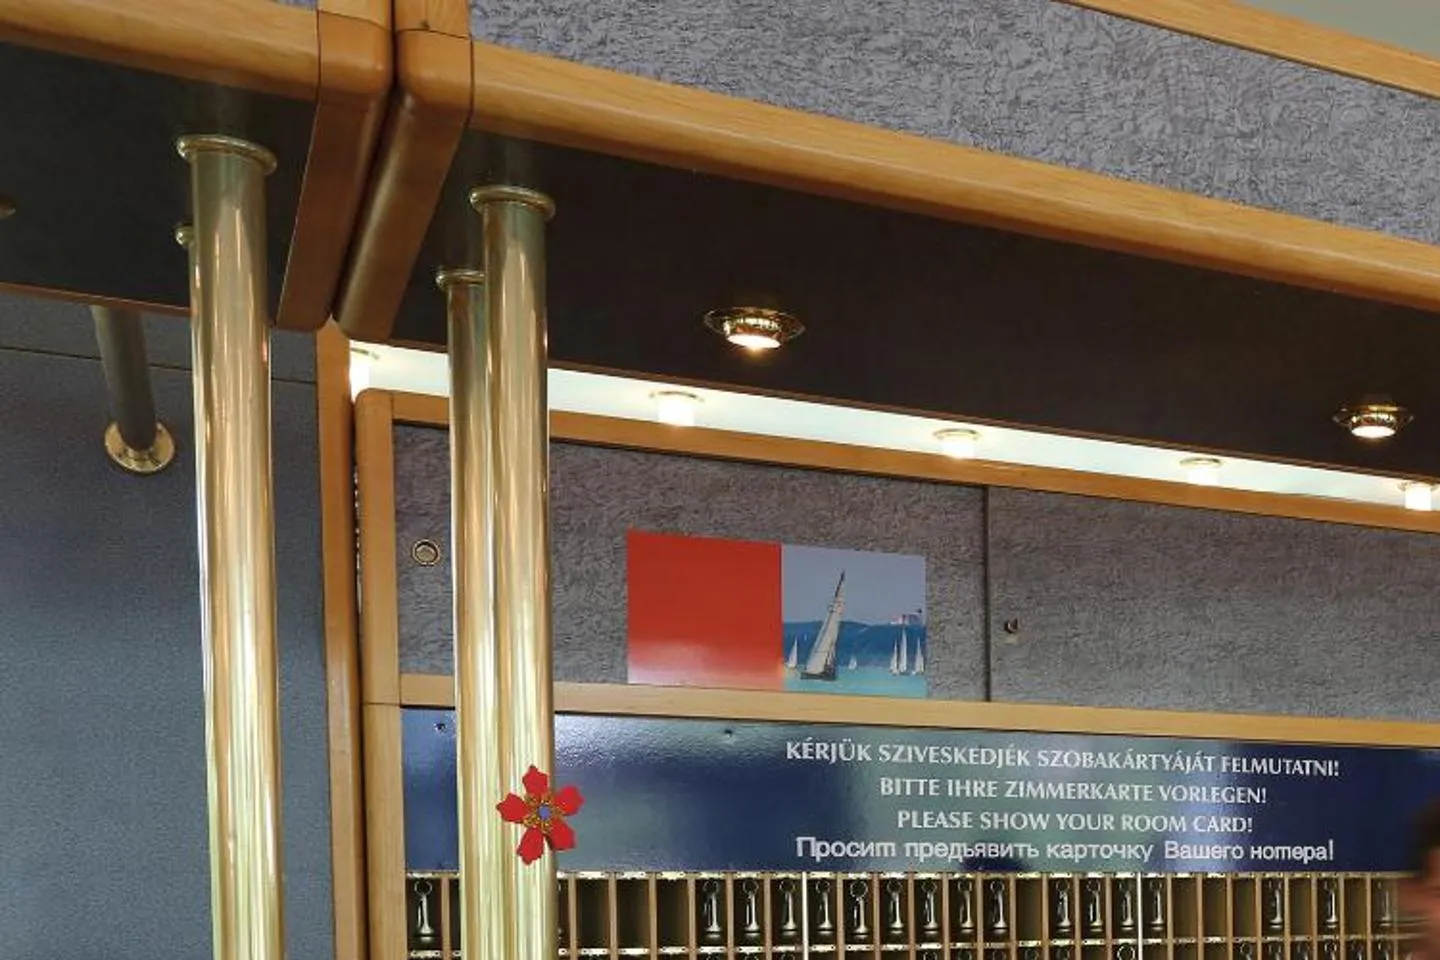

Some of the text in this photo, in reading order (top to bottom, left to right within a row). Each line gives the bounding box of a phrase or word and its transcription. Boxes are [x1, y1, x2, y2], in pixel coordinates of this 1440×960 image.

[786, 737, 1340, 777] KÉRJÜK SZIVESKEDJÉK SZOBAKÁRTYÁJÁT FELMUTATNI!
[880, 777, 1267, 804] BITTE IHRE ZIMMERKARTE VORLEGEN!
[897, 810, 1253, 833] PLEASE SHOW YOUR ROOM CARD!
[1046, 842, 1155, 863] карточку
[1164, 840, 1245, 860] Вашего
